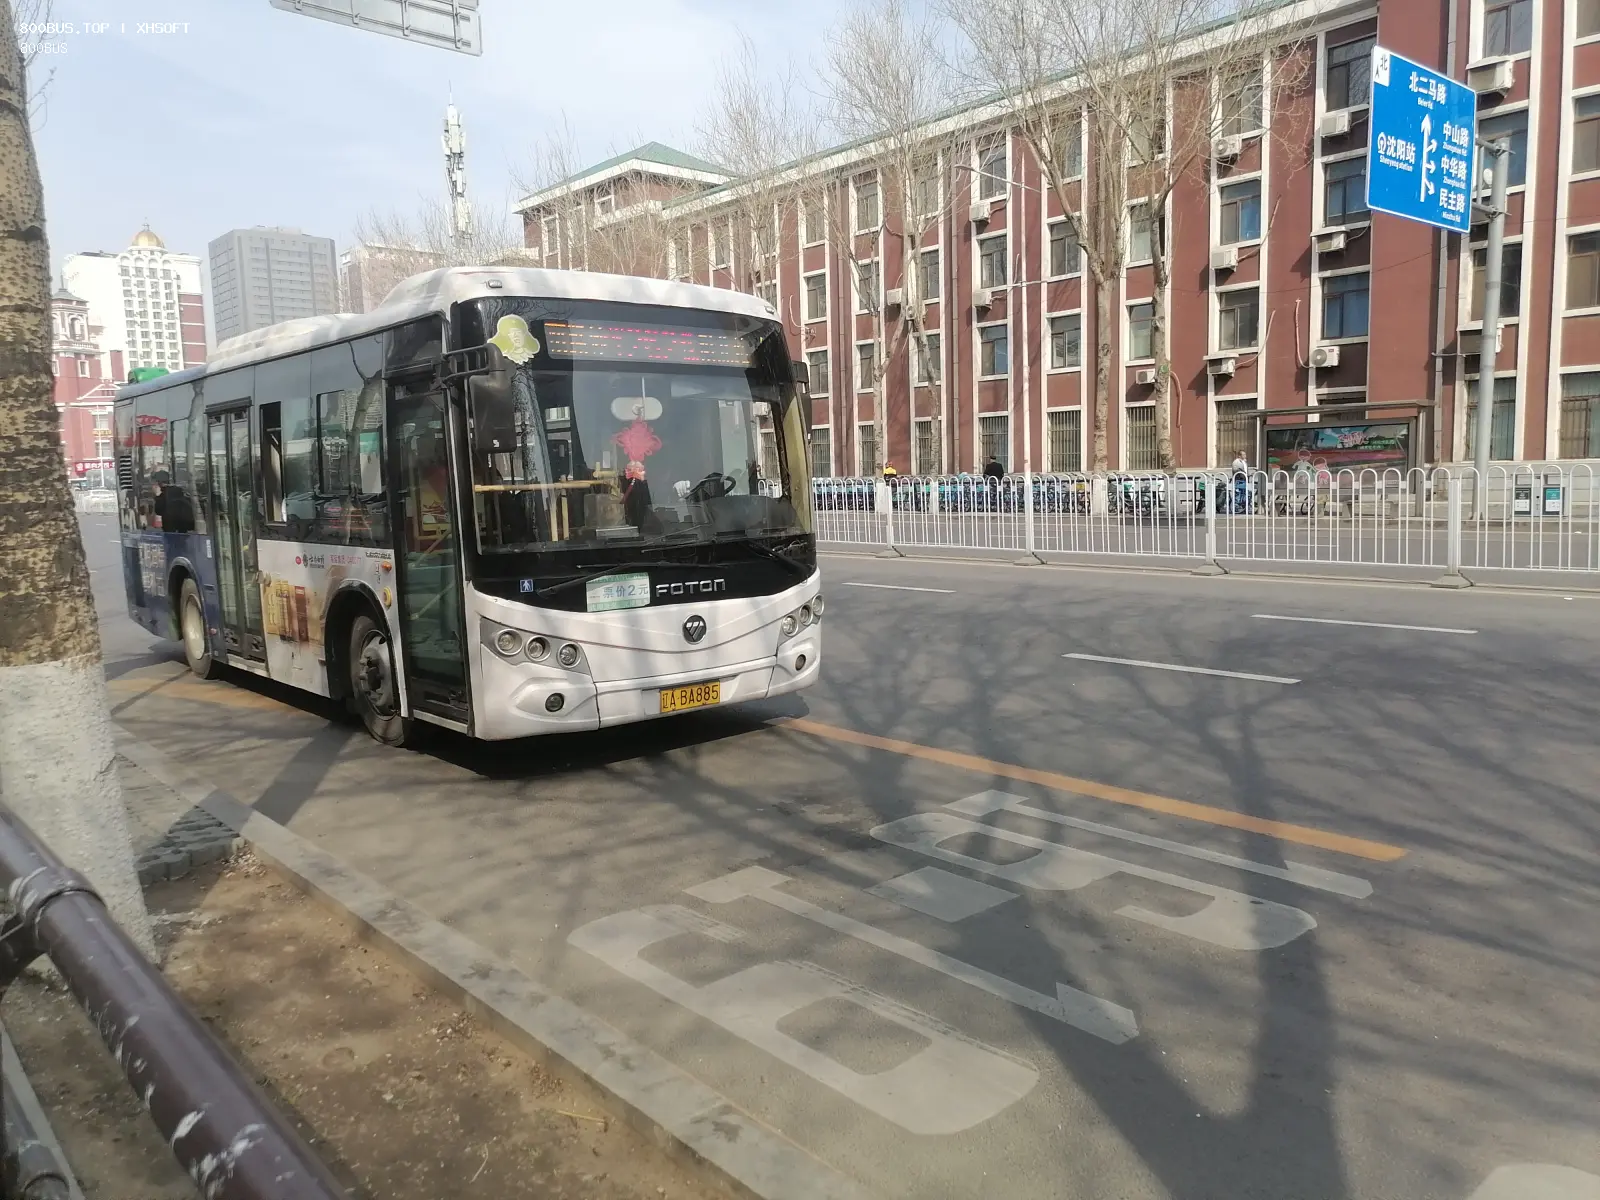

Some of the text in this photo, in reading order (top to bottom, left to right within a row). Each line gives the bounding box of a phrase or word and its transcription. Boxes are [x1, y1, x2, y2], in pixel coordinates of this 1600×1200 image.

[1380, 54, 1388, 71] 北
[1409, 71, 1446, 105] 北二马路
[1443, 120, 1469, 148] 中山路
[1386, 134, 1416, 165] 沈阳站
[1441, 154, 1467, 181] 中华路
[1439, 187, 1465, 213] 民主路
[602, 583, 649, 599] 票价2元
[655, 578, 726, 598] FOTON
